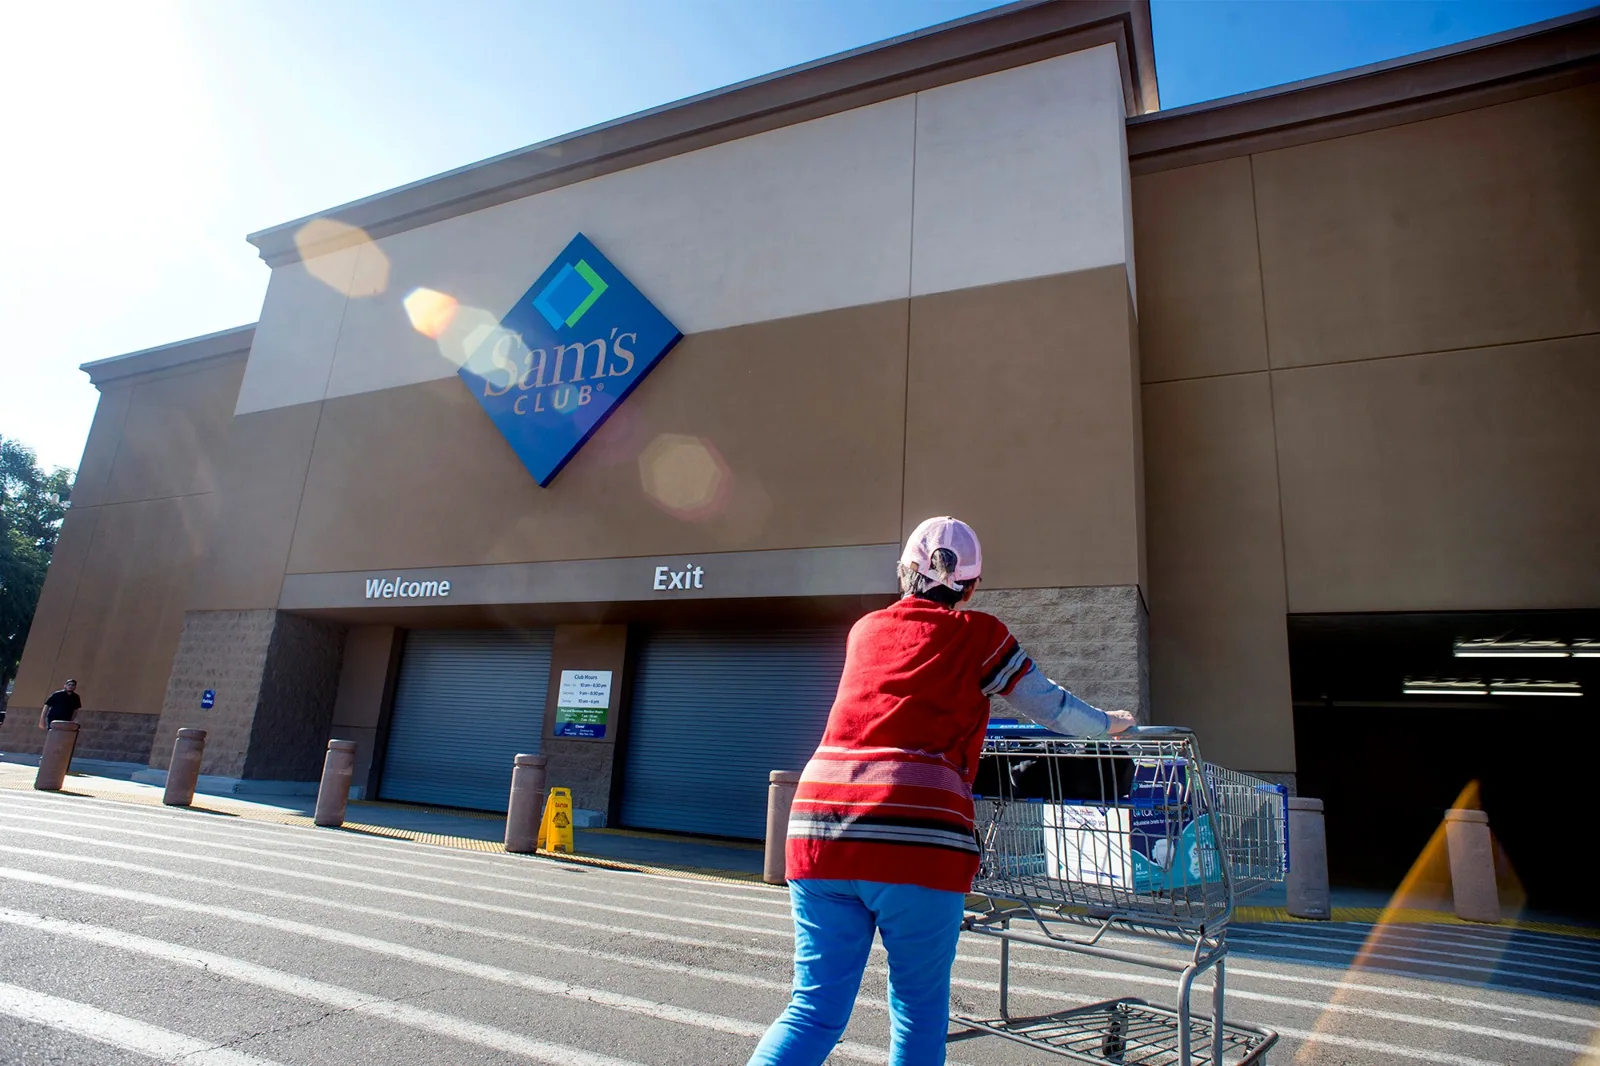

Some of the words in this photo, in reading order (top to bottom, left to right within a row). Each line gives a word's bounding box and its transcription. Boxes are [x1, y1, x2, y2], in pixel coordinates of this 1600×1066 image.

[483, 327, 638, 397] Sam's
[364, 576, 451, 600] Welcome
[653, 563, 705, 591] Exit
